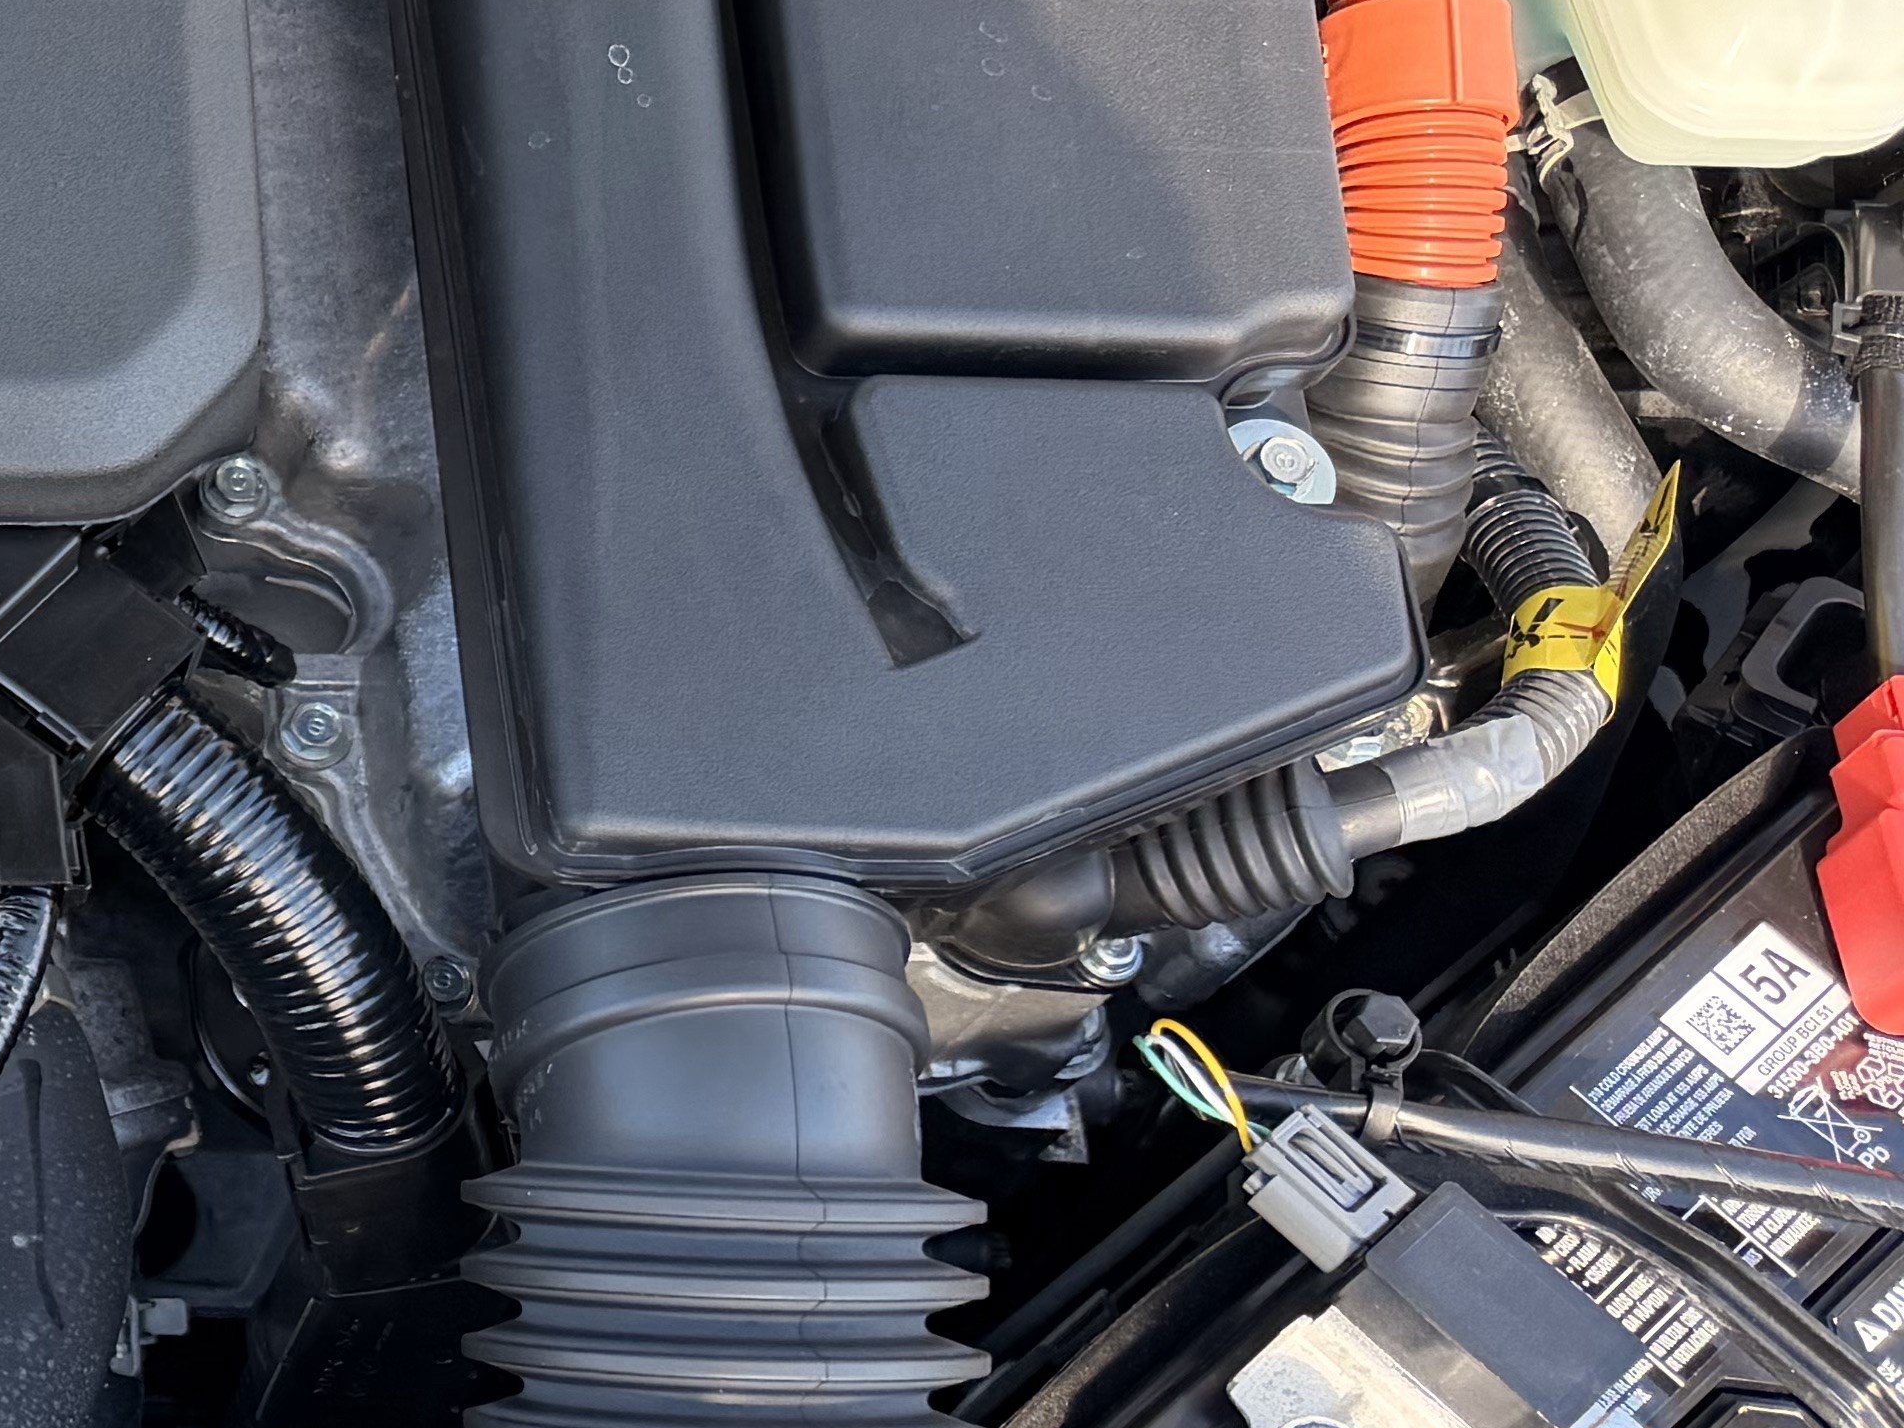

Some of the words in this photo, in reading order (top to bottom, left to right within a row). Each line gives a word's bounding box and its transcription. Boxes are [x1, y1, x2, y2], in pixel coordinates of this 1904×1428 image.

[1738, 937, 1813, 1013] 5A
[1755, 1031, 1802, 1080] GROUP
[1794, 1013, 1822, 1042] BCI
[1813, 1001, 1834, 1022] 51
[1765, 1004, 1862, 1107] 31500-3B0-A01
[1856, 1138, 1893, 1175] Pb
